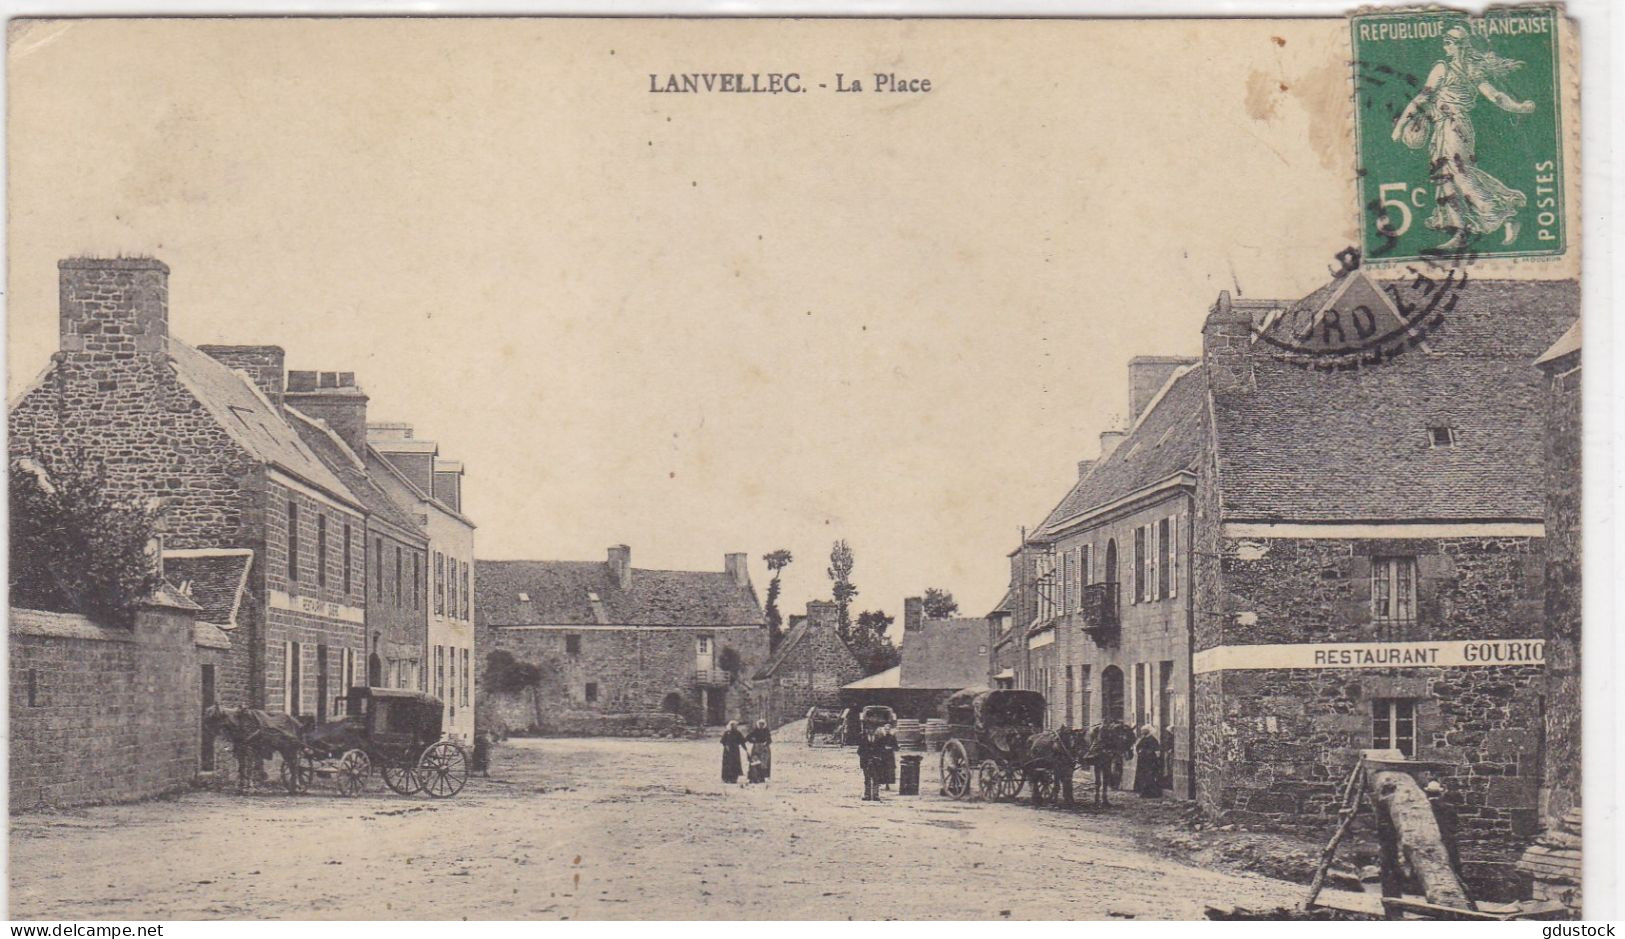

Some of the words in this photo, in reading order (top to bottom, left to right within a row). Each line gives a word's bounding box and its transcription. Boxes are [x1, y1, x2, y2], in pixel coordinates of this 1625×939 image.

[1360, 21, 1444, 41] REPUBLIQUE
[1471, 17, 1548, 36] FRANÇAISE
[1535, 160, 1556, 240] POSTES
[1315, 647, 1440, 664] RESTAURANT
